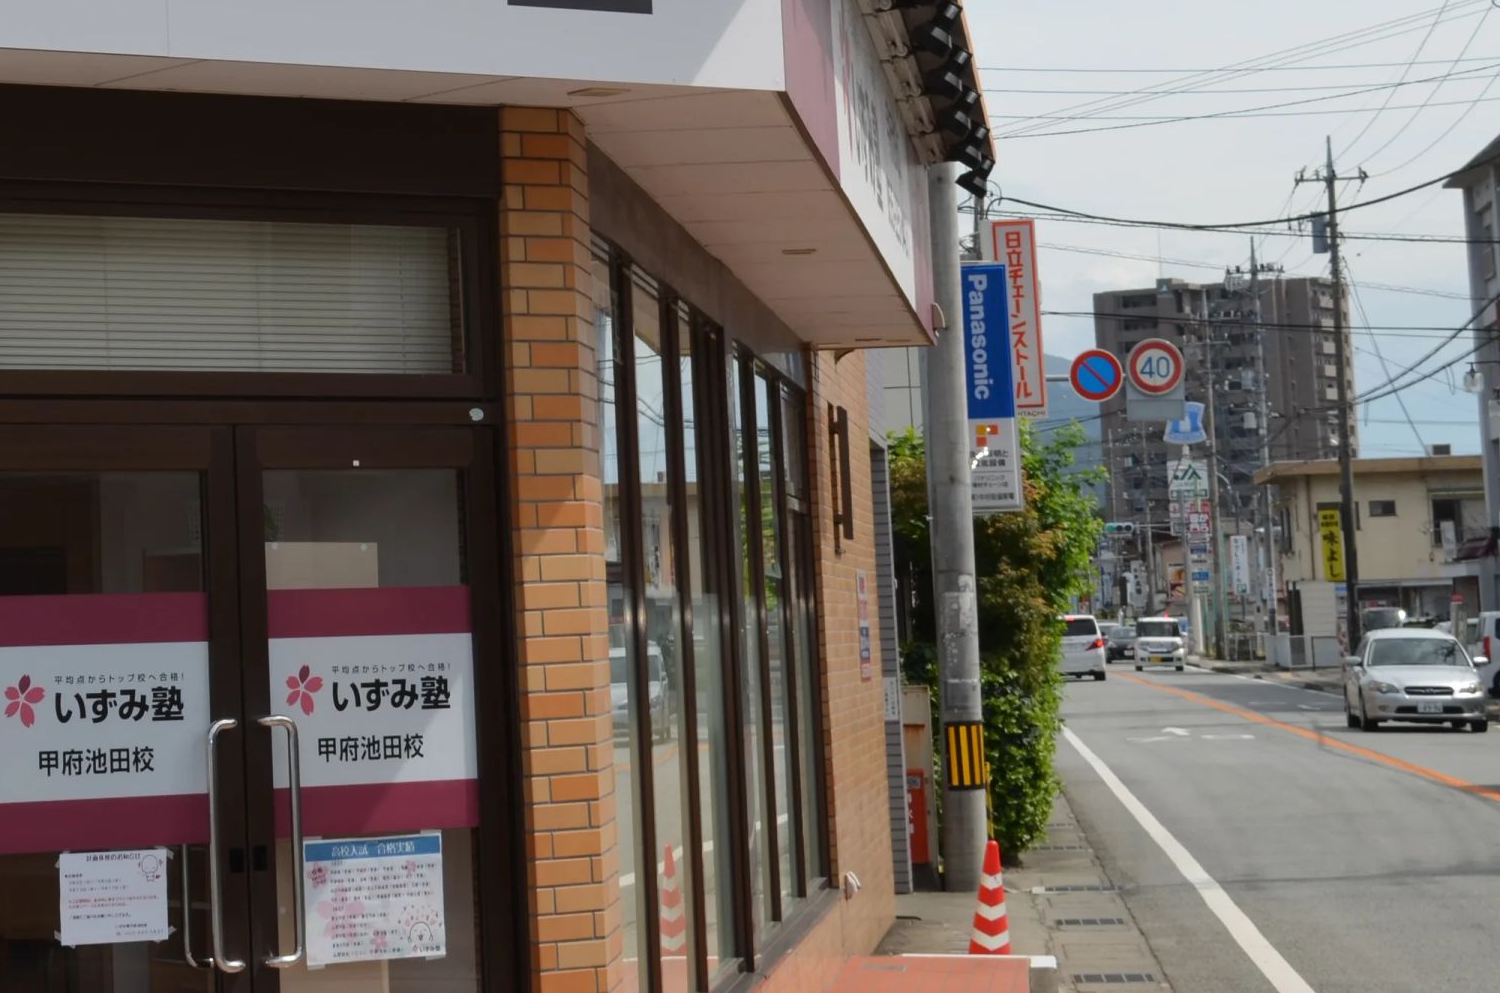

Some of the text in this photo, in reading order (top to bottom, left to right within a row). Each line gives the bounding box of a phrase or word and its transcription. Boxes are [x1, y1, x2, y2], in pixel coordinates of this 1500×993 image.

[1005, 231, 1033, 399] 日立チェーンストール
[968, 273, 994, 401] Panasonic
[1140, 356, 1170, 379] 40
[55, 686, 184, 724] いずみ塾
[332, 675, 451, 712] いずみ塾
[38, 746, 155, 777] 甲府池田校
[318, 733, 424, 763] 甲府池田校
